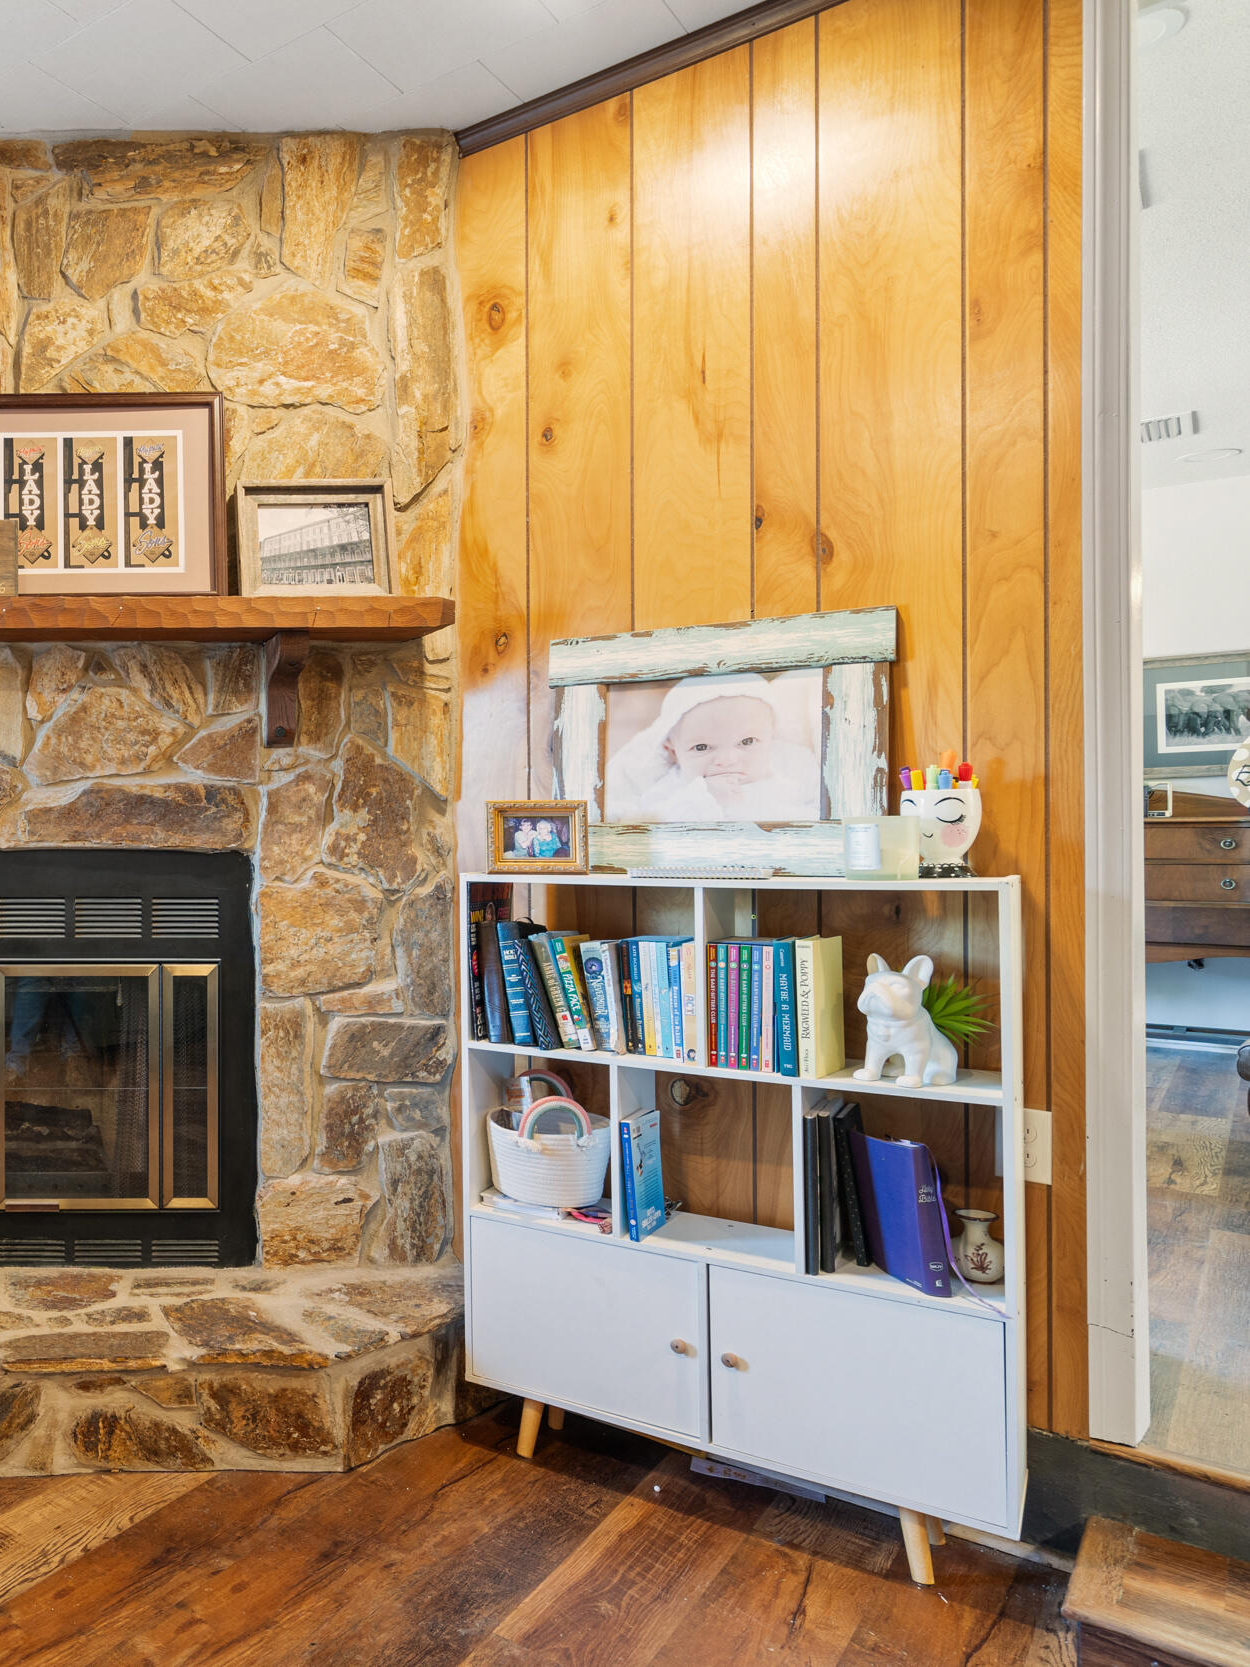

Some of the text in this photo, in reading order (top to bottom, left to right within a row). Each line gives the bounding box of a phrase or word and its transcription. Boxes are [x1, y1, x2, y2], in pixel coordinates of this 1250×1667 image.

[22, 464, 40, 525] LADY
[81, 464, 100, 525] LADY
[142, 463, 161, 524] LADY
[779, 974, 789, 1001] MAYBE
[800, 959, 809, 987] POPPY
[562, 973, 581, 1012] PIZZA FACE
[800, 990, 811, 999] &
[781, 1013, 792, 1051] MERMAID
[801, 1000, 810, 1039] RAGWEED
[918, 1194, 937, 1204] Bible
